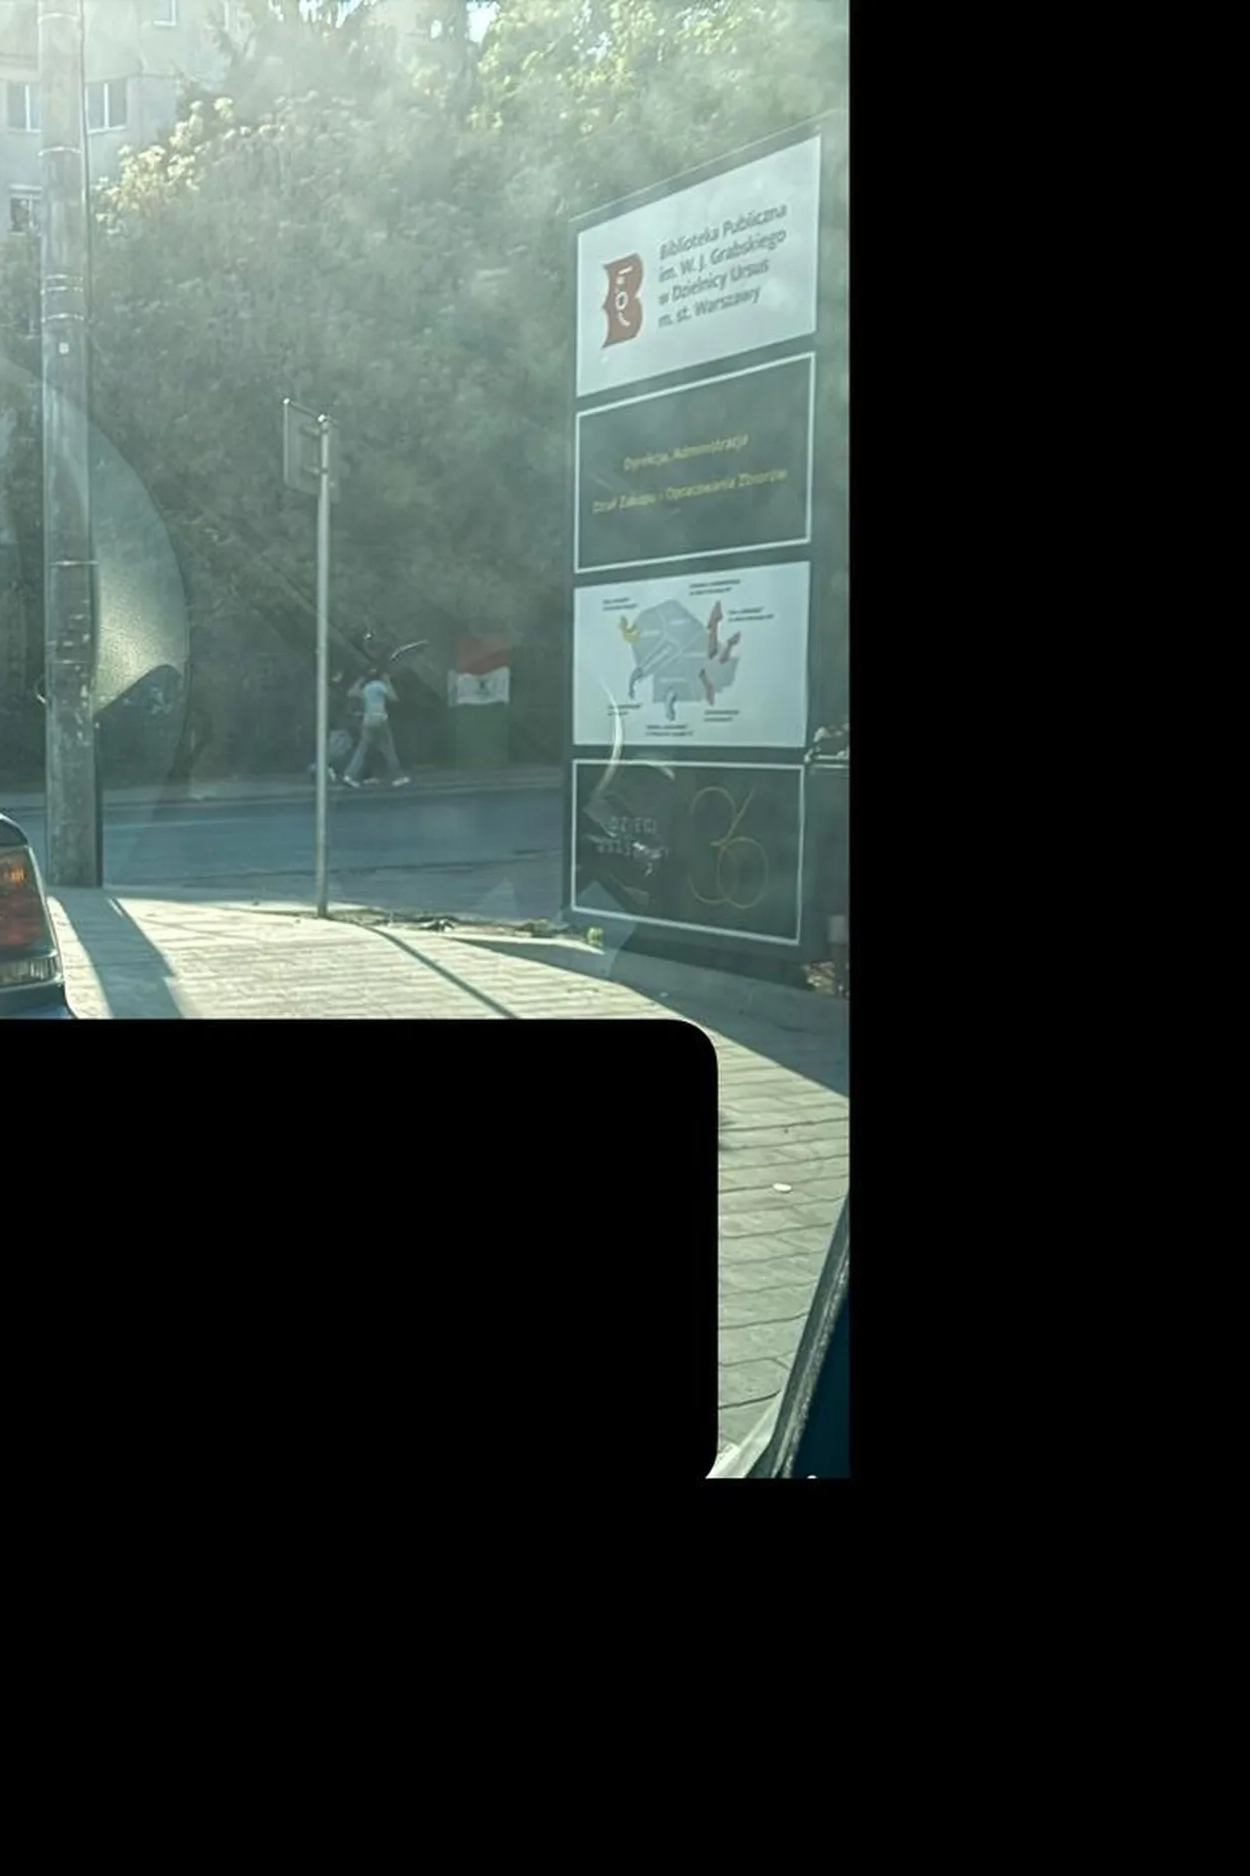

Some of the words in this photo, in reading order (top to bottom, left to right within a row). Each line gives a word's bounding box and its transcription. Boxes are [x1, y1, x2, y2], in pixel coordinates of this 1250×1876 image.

[658, 227, 719, 260] Biblioteka
[722, 204, 788, 238] Publiczna
[658, 266, 678, 283] im.
[680, 257, 696, 275] W.
[698, 254, 708, 273] J.
[710, 230, 787, 265] Grabskiego
[658, 293, 669, 305] w
[672, 272, 728, 302] Dzielnicy
[730, 258, 770, 281] Ursus
[658, 314, 673, 328] m.
[676, 306, 692, 323] st.
[694, 285, 762, 317] Warszawy
